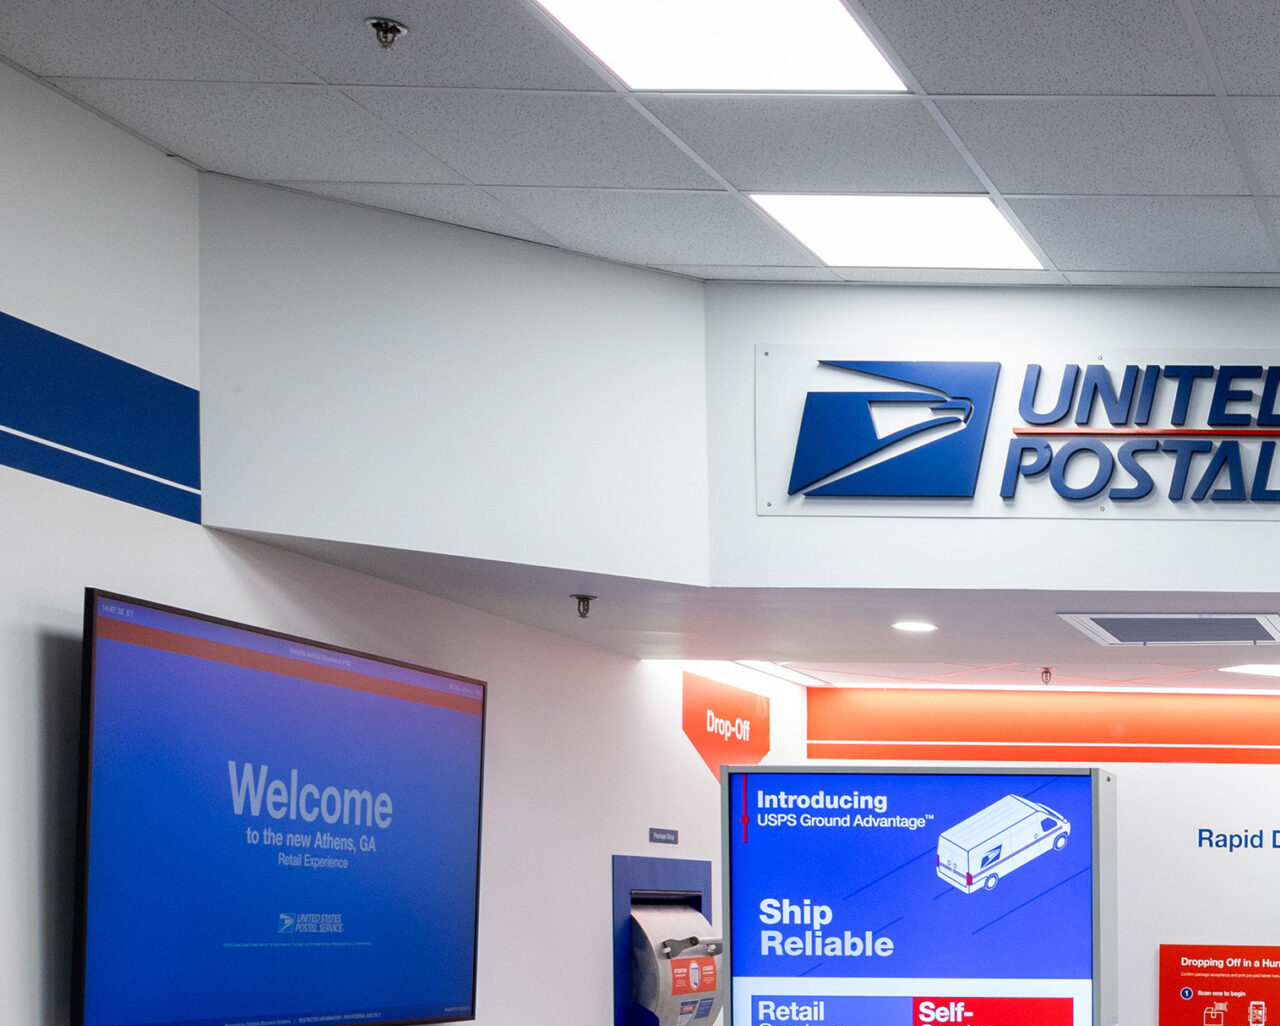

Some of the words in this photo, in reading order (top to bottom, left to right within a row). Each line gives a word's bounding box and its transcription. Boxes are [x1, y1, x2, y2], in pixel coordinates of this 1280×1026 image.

[706, 709, 750, 741] Drop-Off
[228, 760, 393, 829] Welcome
[757, 790, 888, 813] Introducing
[757, 813, 797, 827] USPS
[800, 813, 850, 827] Ground
[246, 827, 260, 845] to
[263, 827, 283, 846] the
[287, 833, 312, 848] new
[314, 832, 357, 854] Athens,
[359, 835, 376, 852] GA
[1198, 829, 1264, 852] Rapid
[278, 852, 303, 867] Retail
[304, 854, 349, 869] Experience
[296, 913, 321, 923] UNITED
[759, 898, 833, 930] Ship
[761, 930, 894, 957] Reliable
[1181, 957, 1224, 968] Dropping
[1226, 958, 1241, 967] Off
[1243, 958, 1252, 968] in
[1254, 960, 1260, 968] a
[1231, 990, 1246, 998] begin
[758, 1001, 825, 1021] Retail
[919, 1001, 973, 1022] Self-
